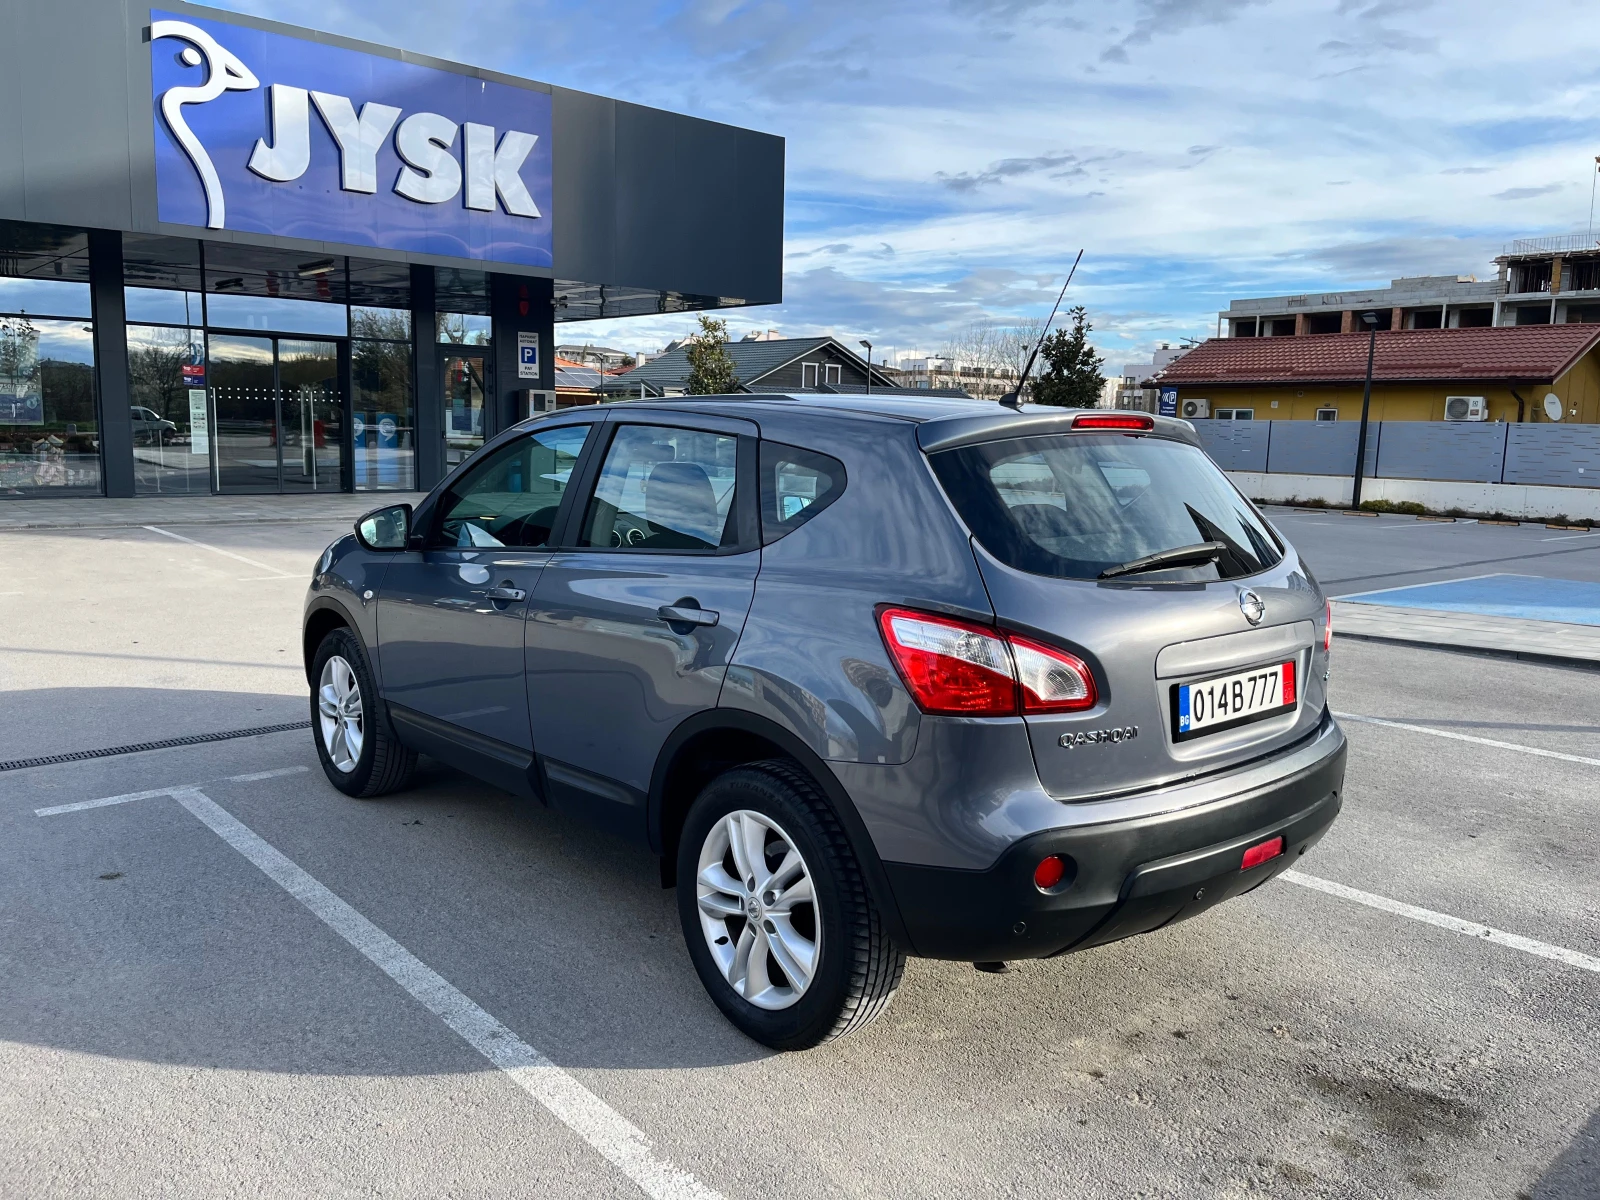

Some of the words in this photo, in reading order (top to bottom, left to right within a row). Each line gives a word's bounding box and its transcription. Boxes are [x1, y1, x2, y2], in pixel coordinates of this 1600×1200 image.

[247, 83, 542, 219] JYSK
[524, 348, 533, 362] P
[1193, 671, 1278, 722] 014B777
[1180, 715, 1189, 726] BG
[1058, 726, 1139, 749] QASHQAI
[729, 781, 783, 808] TURANZA
